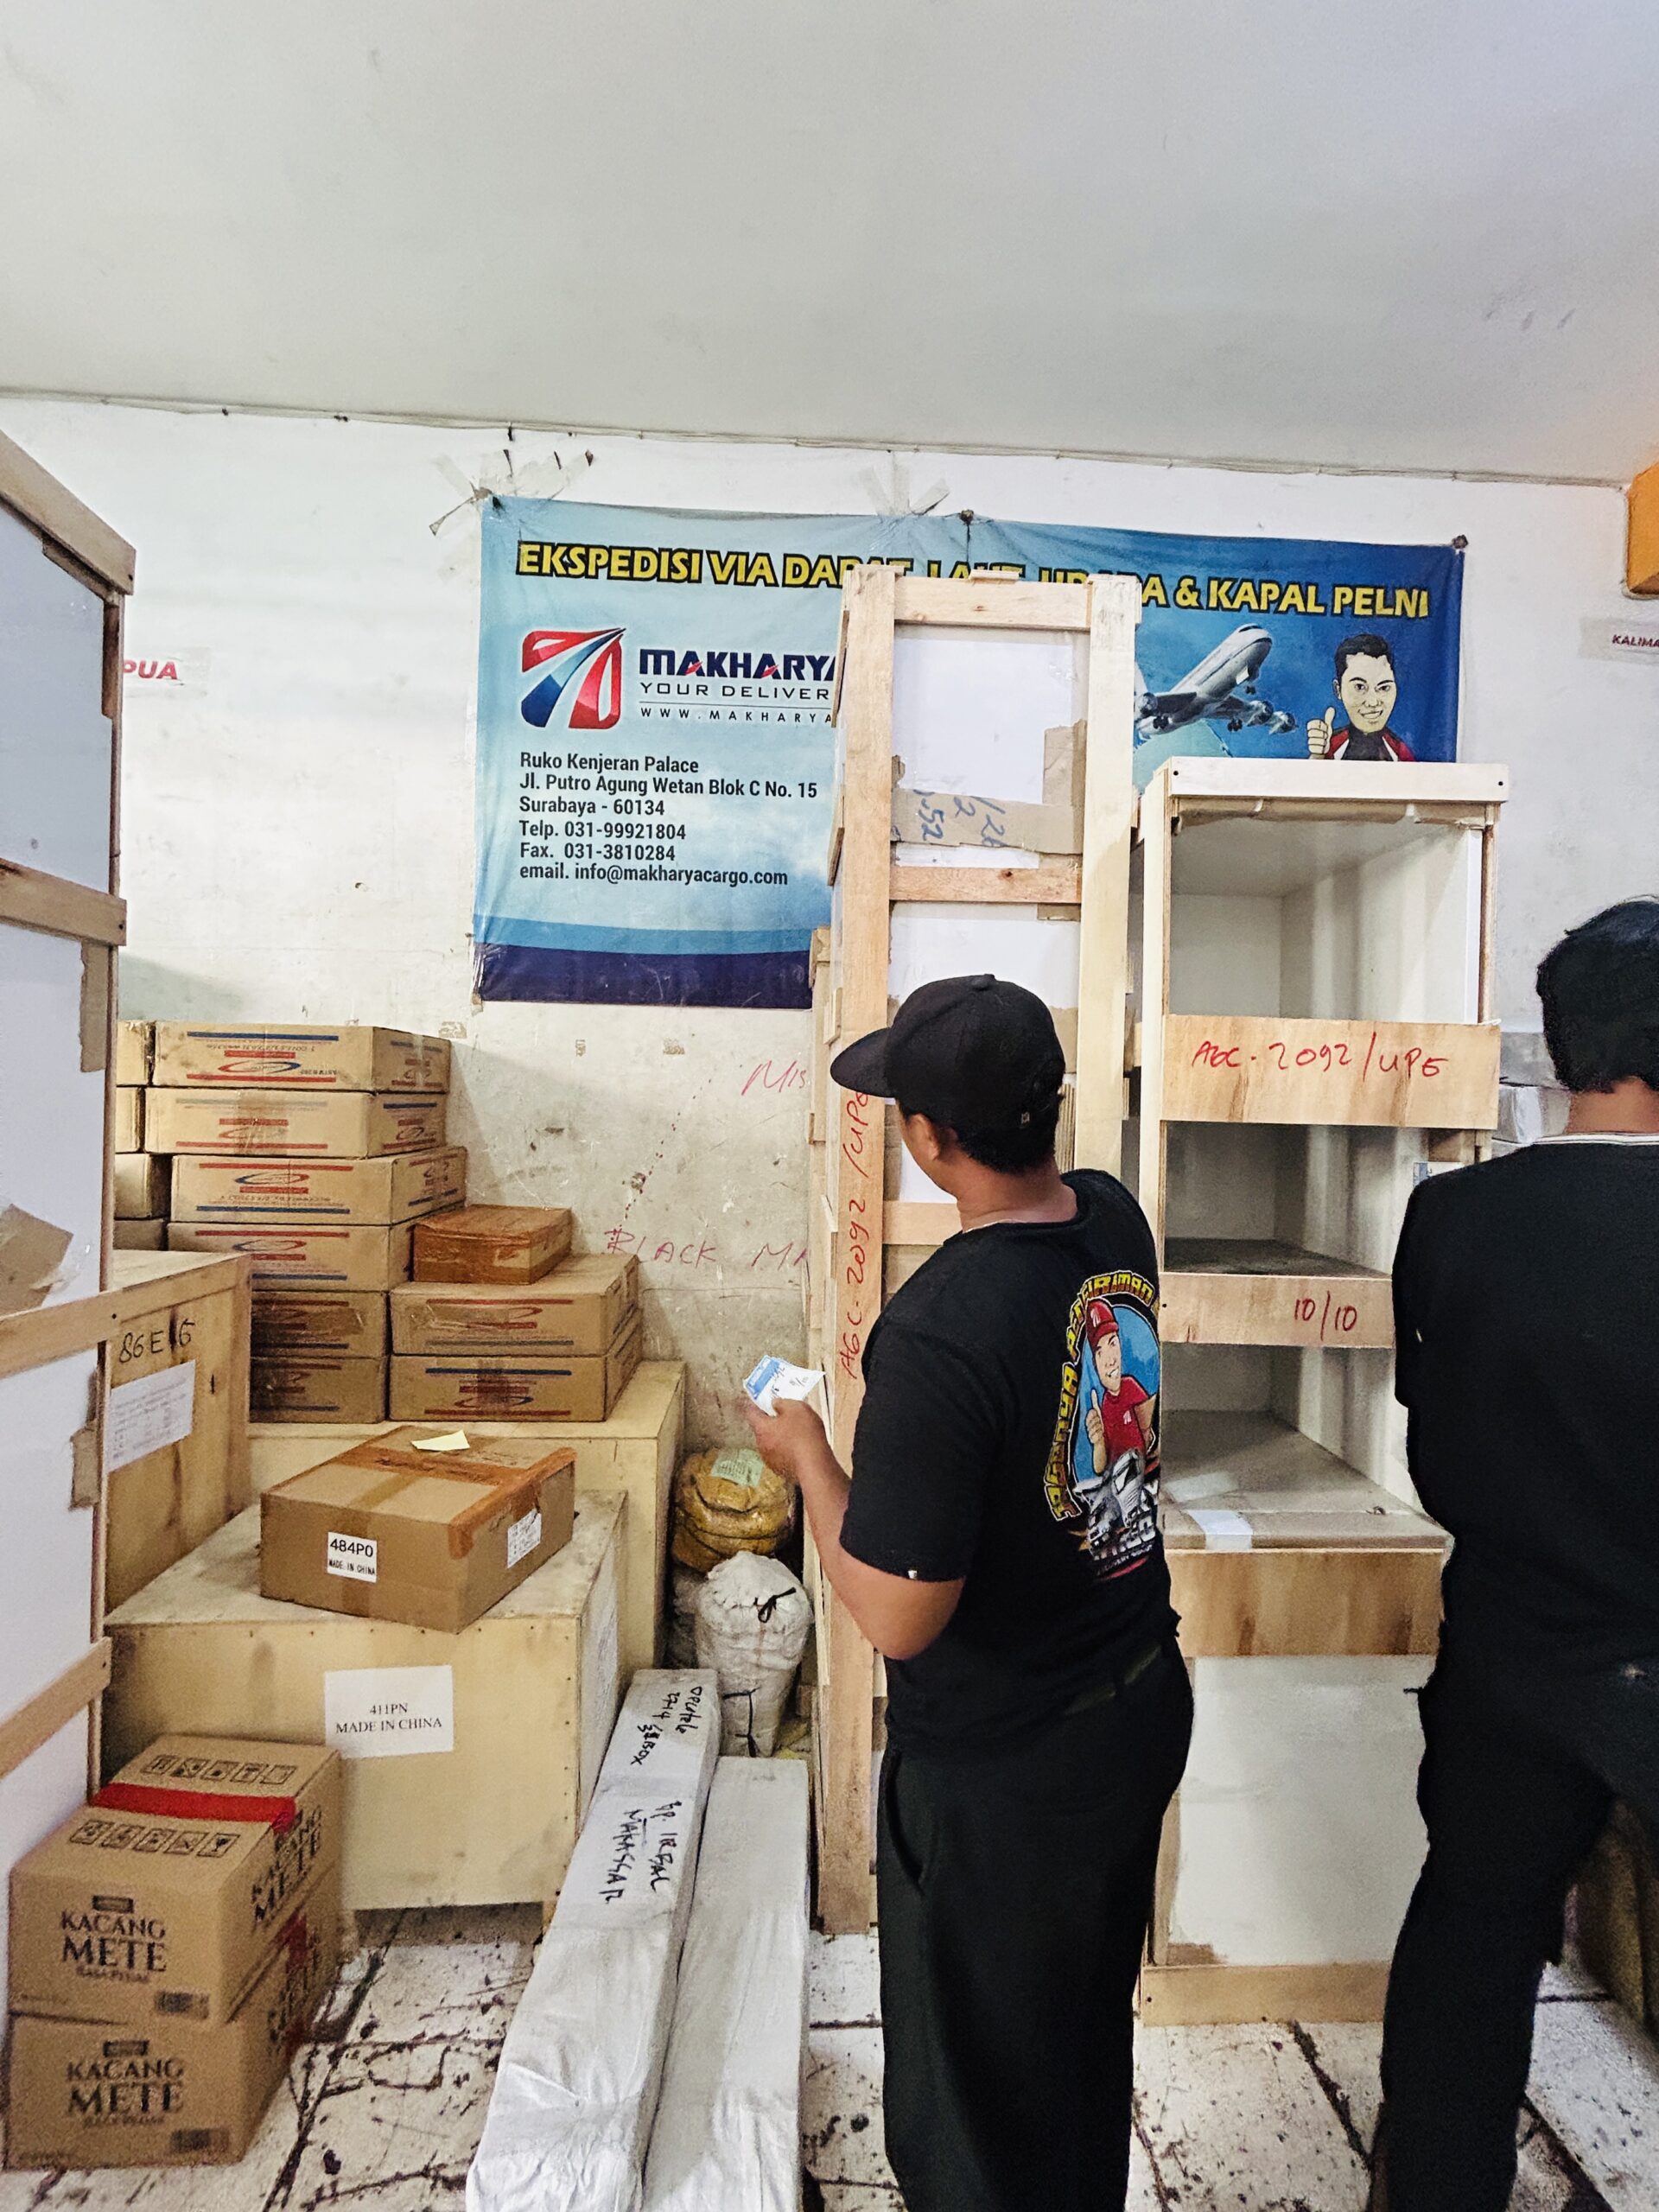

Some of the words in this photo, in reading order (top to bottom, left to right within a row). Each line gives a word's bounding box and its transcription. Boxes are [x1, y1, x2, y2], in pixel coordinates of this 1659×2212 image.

[516, 540, 702, 584] EKSPEDISI
[707, 550, 779, 587] VIA
[1173, 574, 1204, 610] &
[1205, 576, 1327, 616] KAPAL
[1331, 584, 1430, 619] PELNI
[640, 682, 708, 696] YOUR
[520, 752, 563, 769] Ruko
[567, 753, 639, 773] Kenjeran
[645, 756, 699, 772] Palace
[519, 772, 540, 790] Jl.
[546, 774, 591, 791] Putro
[596, 776, 648, 796] Agung
[652, 777, 704, 794] Wetan
[709, 779, 745, 796] Blok
[749, 780, 760, 796] C
[765, 781, 792, 798] No.
[798, 782, 817, 798] 15
[519, 796, 596, 817] Surabaya
[613, 799, 665, 816] 60134
[519, 820, 559, 840] Telp.
[564, 821, 686, 840] 031-99921804
[519, 842, 554, 859] Fax.
[564, 842, 676, 861] 031-3810284
[519, 862, 569, 880] email.
[575, 864, 788, 887] info@makharyacargo.com
[1294, 1290, 1357, 1341] 10/10
[329, 1559, 344, 1570] MADE
[347, 1561, 355, 1572] IN
[358, 1564, 376, 1576] CHINA
[370, 1703, 409, 1715] 411PN
[336, 1721, 377, 1733] MADE
[381, 1721, 395, 1732] IN
[398, 1718, 442, 1730] CHINA
[61, 1910, 167, 1940] KACANG
[62, 1936, 167, 1973] METE
[67, 2057, 184, 2082] KACANG
[68, 2081, 184, 2113] METE
